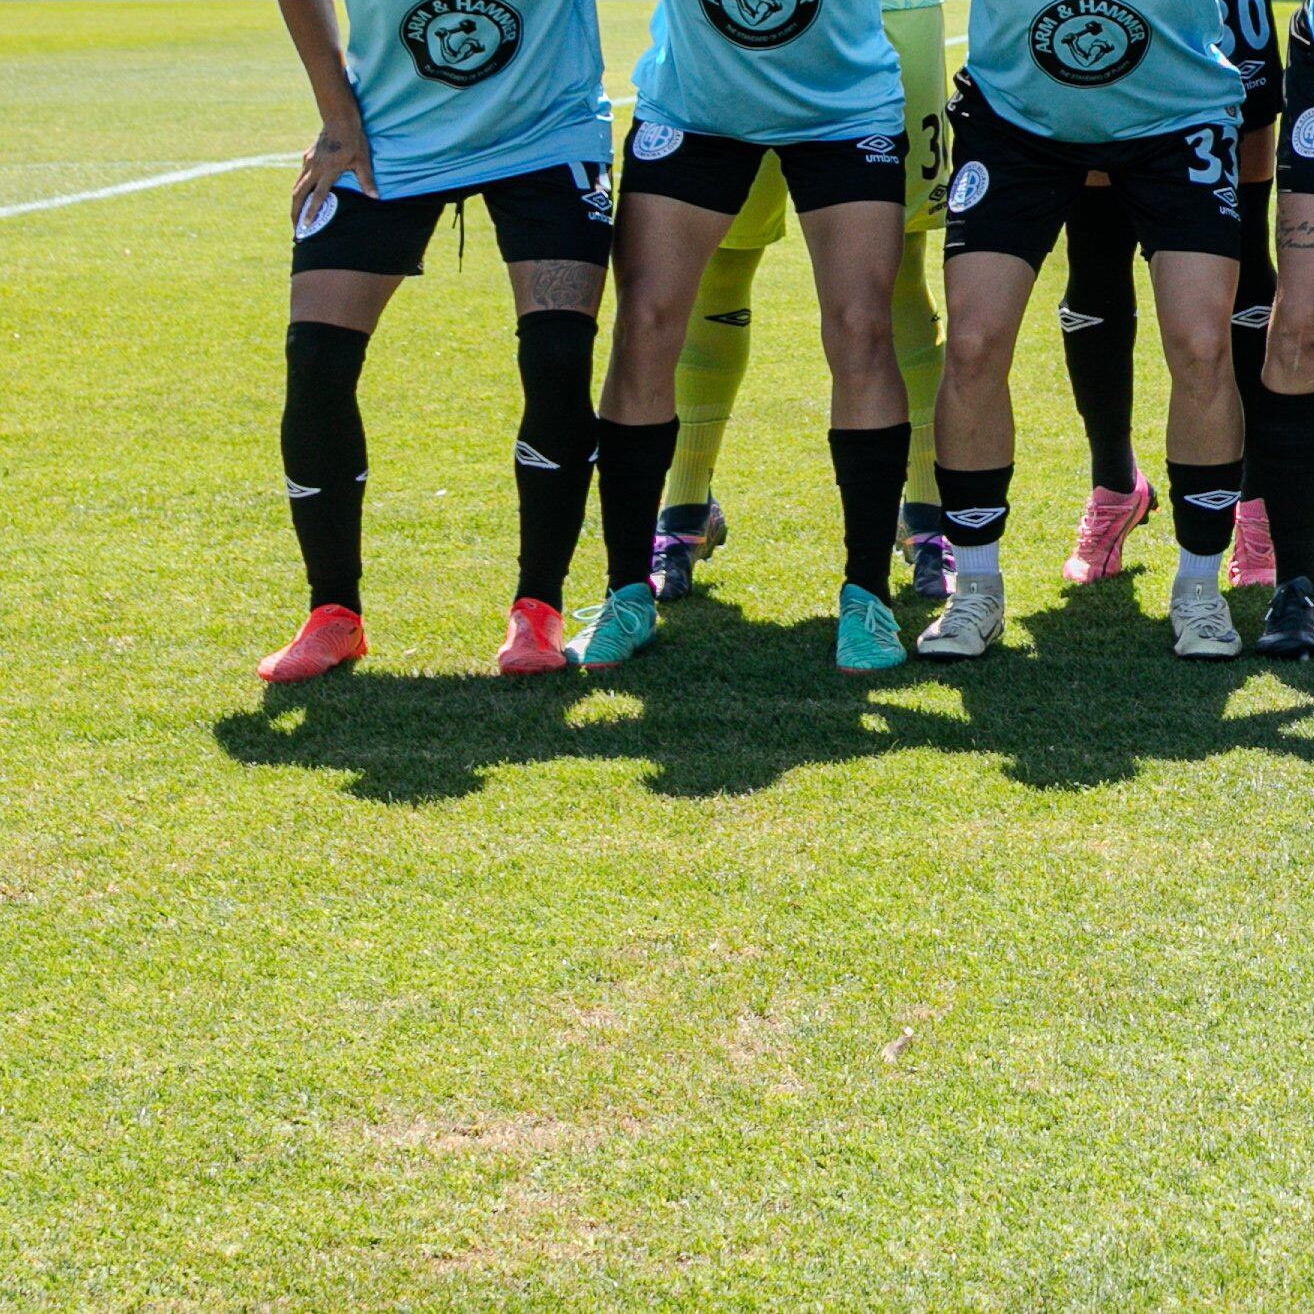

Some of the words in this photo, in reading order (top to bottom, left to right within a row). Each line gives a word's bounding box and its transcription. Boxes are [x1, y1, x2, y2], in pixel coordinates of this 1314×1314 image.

[407, 10, 428, 42] ARM
[432, 0, 450, 13] &
[1035, 16, 1058, 54] ARM
[1057, 4, 1075, 19] &
[1079, 0, 1145, 44] HAMMER
[865, 153, 900, 165] umbro
